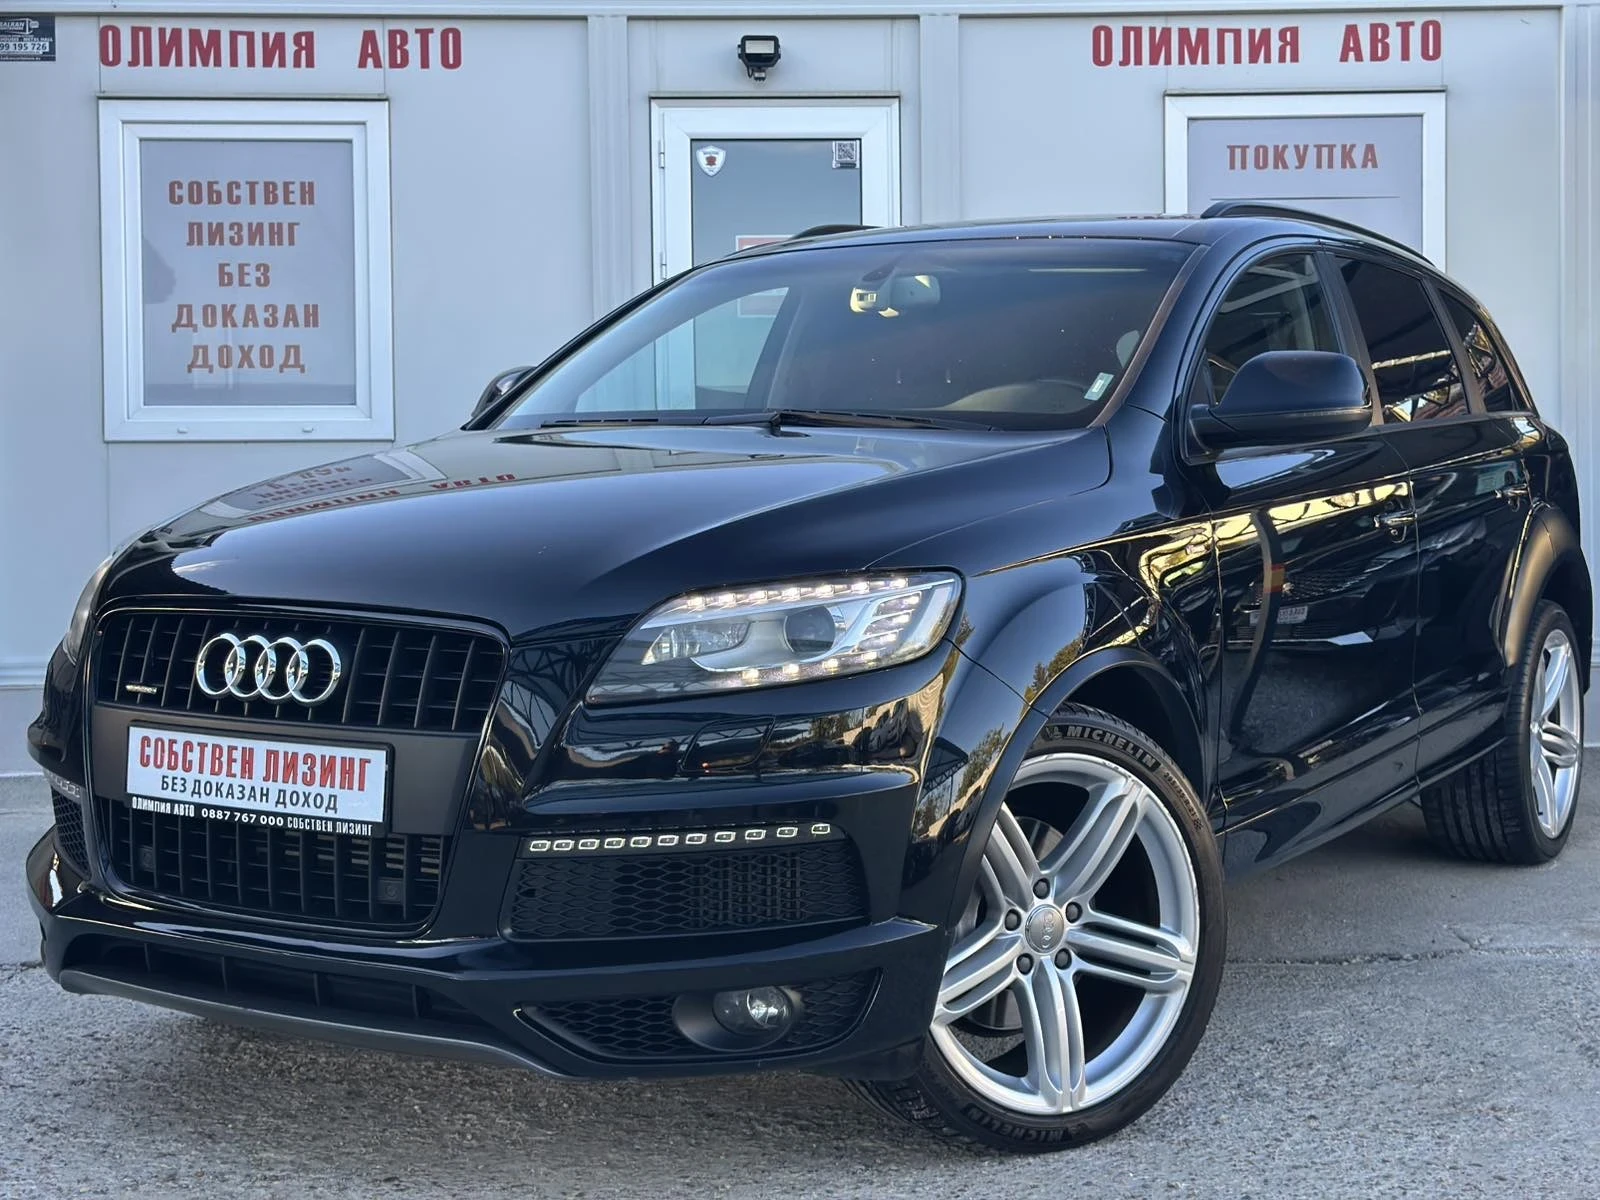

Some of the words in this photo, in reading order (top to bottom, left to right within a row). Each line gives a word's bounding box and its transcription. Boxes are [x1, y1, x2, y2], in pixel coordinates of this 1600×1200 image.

[13, 43, 28, 51] 195
[31, 43, 47, 51] 726
[100, 25, 316, 69] ОЛИМПИЯ
[358, 27, 463, 70] АВТО
[1092, 24, 1301, 68] ОЛИМПИЯ
[1340, 20, 1442, 63] АВТО
[1227, 143, 1379, 171] ПОКУПКА
[168, 180, 316, 206] СОБСТВЕН
[186, 222, 299, 247] ЛИЗИНГ
[218, 263, 271, 288] БЕЗ
[171, 303, 320, 333] ДОКАЗАН
[187, 345, 305, 373] ДОХОД
[1066, 725, 1158, 768] MICHELIN
[139, 735, 255, 780] СОБСТВЕН
[263, 748, 371, 792] ЛИЗИНГ
[161, 774, 187, 793] БЕЗ
[191, 777, 270, 804] ДОКАЗАН
[275, 789, 338, 814] ДОХОД
[132, 796, 171, 814] ОЛИМПИЯ
[173, 803, 195, 818] АВТО
[201, 808, 231, 821] 0887
[233, 812, 257, 824] 767
[260, 815, 284, 827] 000
[287, 816, 333, 833] СОБСТВЕН
[335, 821, 373, 837] ЛИЗИНГ
